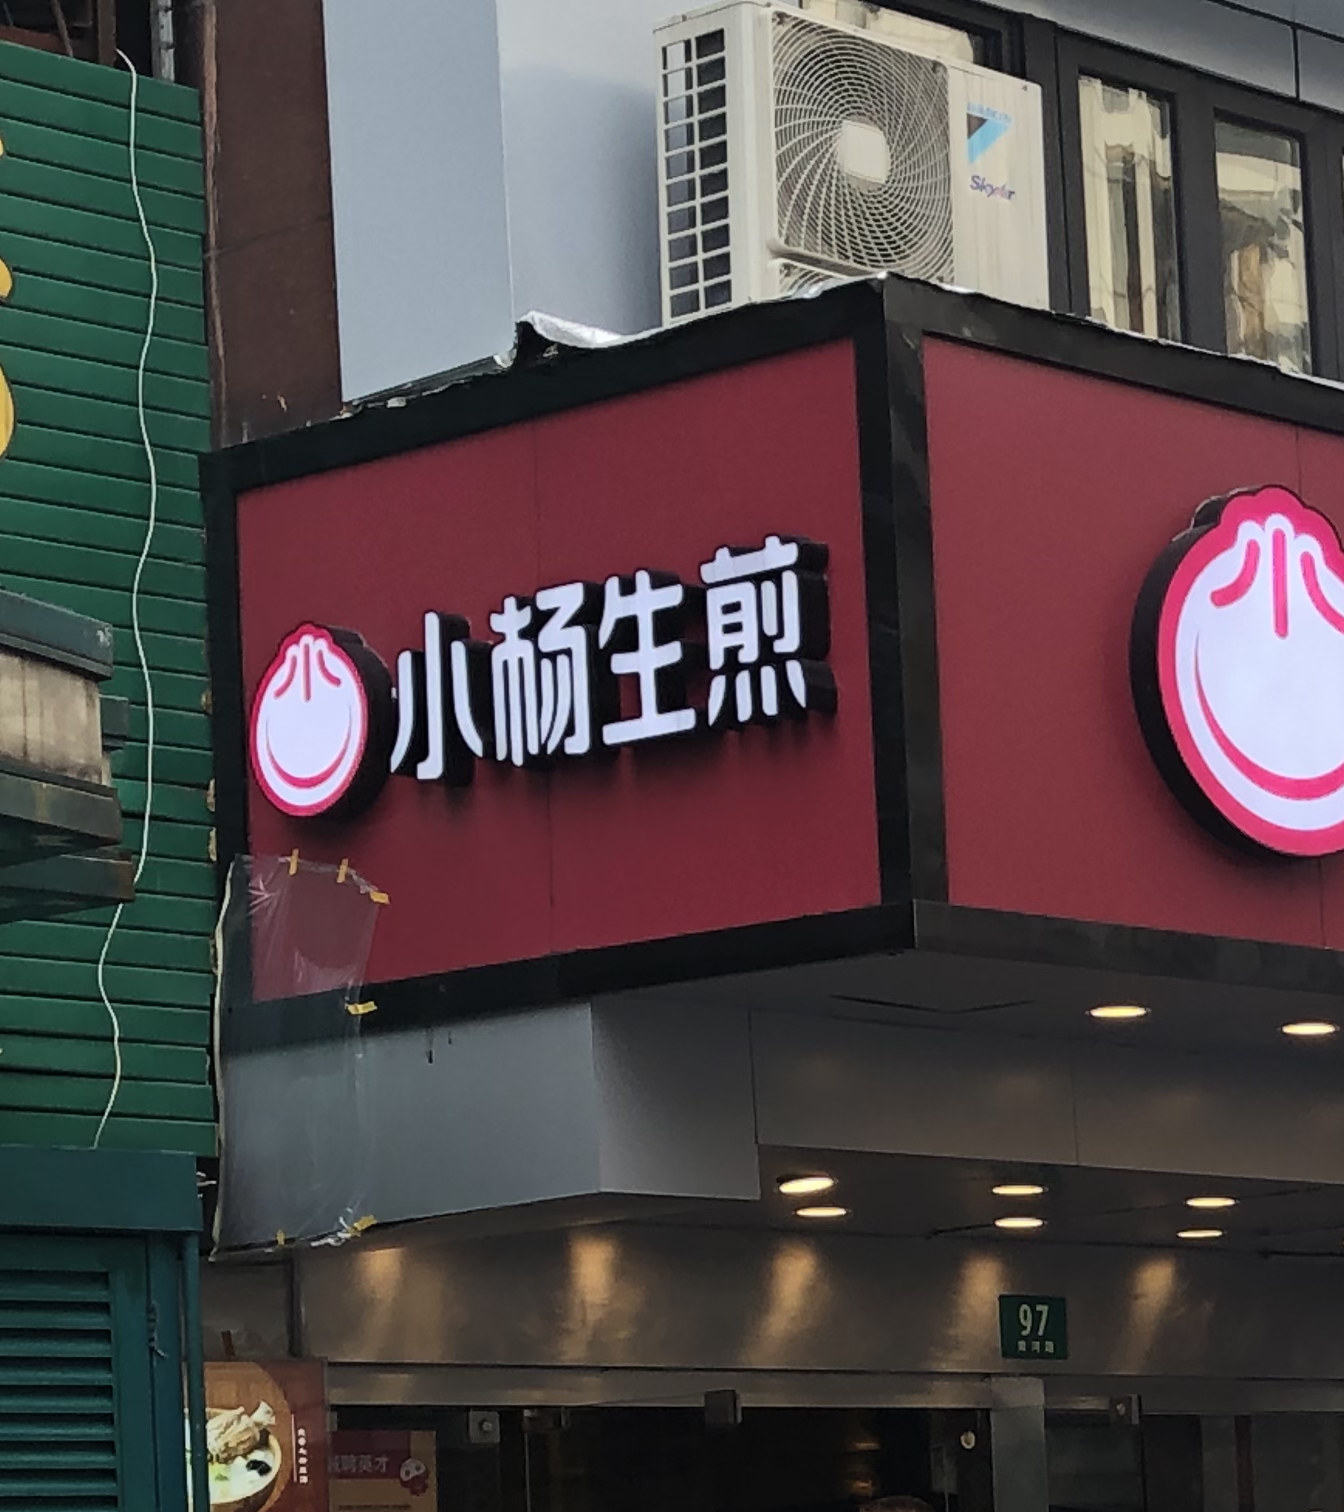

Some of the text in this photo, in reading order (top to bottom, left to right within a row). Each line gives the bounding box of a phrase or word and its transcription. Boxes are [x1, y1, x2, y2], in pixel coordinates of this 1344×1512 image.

[390, 535, 807, 781] 小杨生煎
[1018, 1303, 1049, 1337] 97
